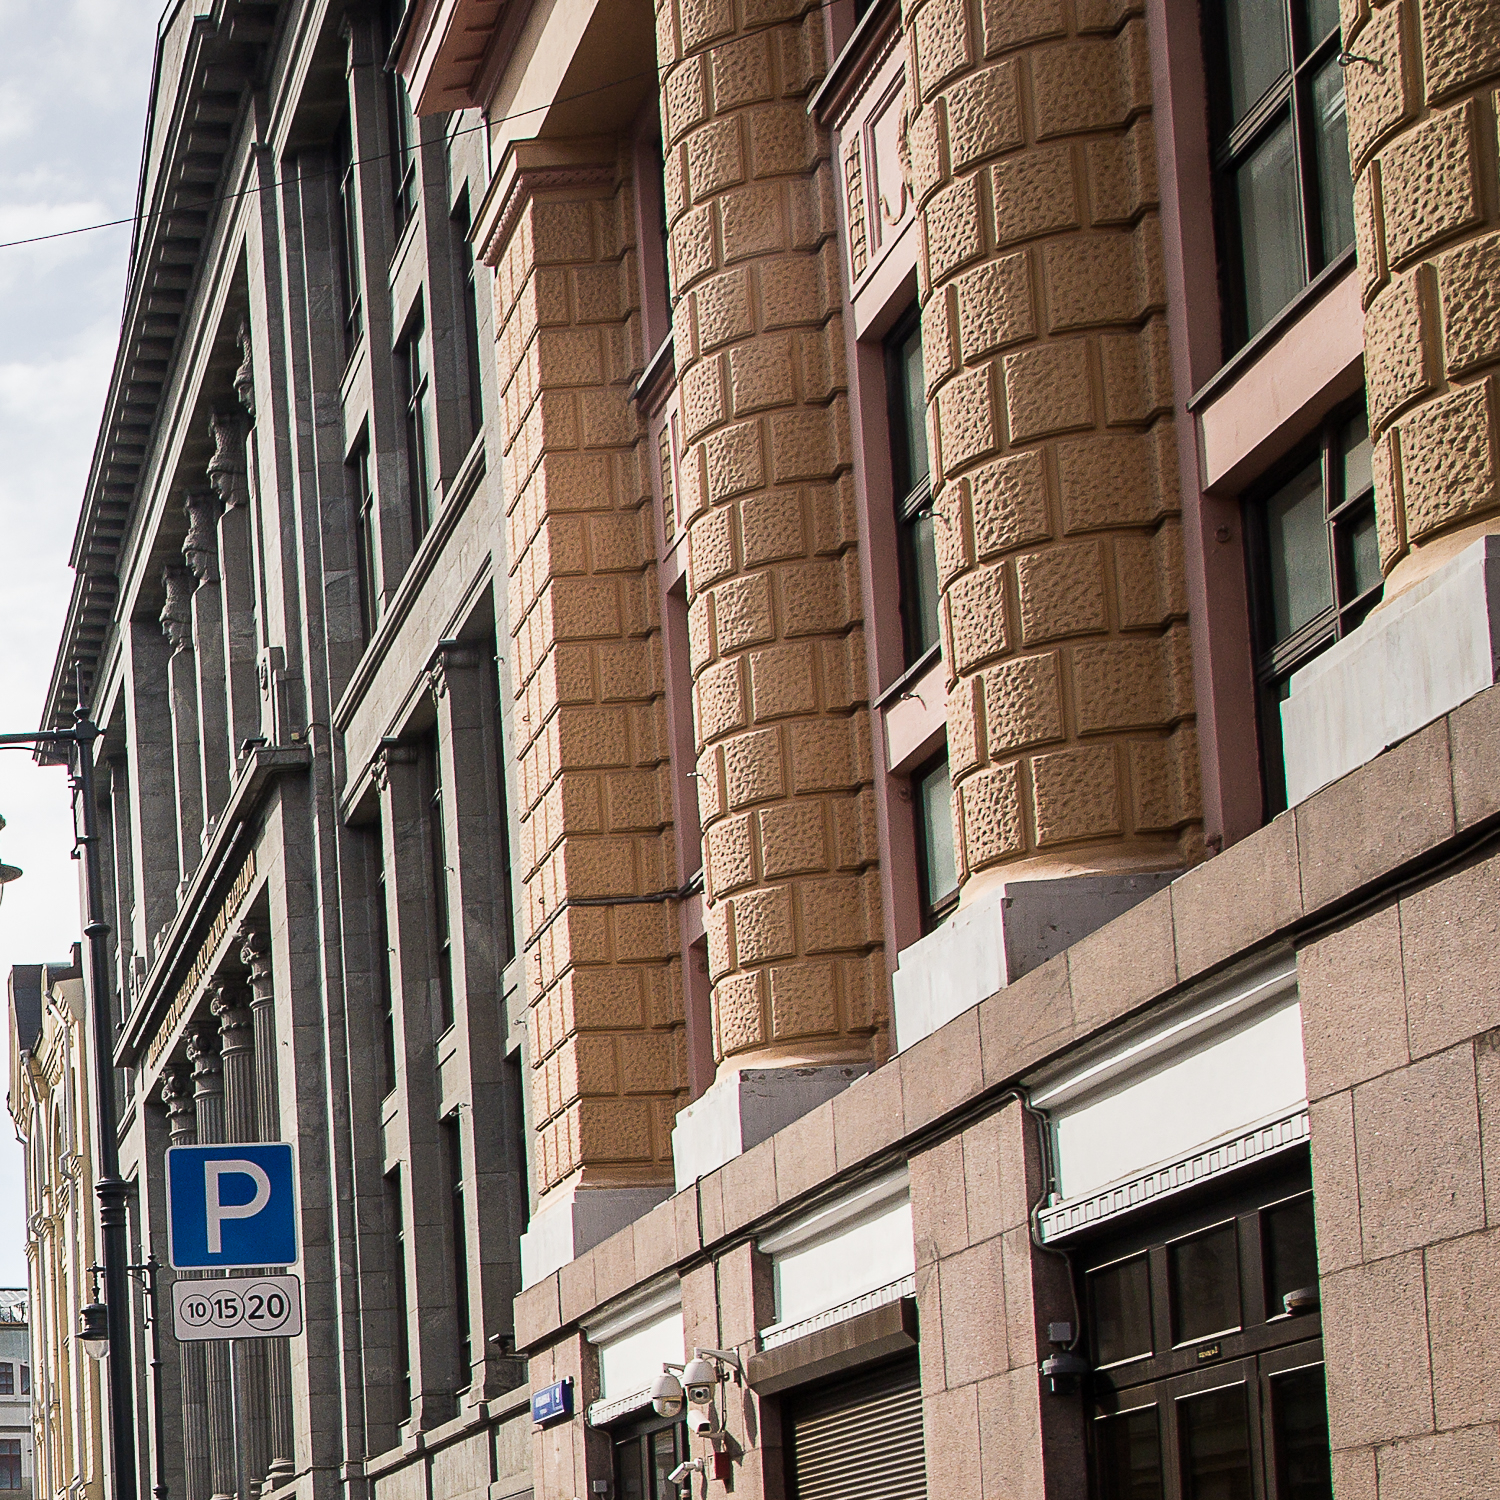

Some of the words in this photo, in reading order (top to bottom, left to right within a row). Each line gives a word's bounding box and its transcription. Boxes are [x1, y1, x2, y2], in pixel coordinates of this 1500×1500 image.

[204, 1159, 271, 1254] P
[187, 1302, 207, 1318] 10
[213, 1297, 238, 1320] 15
[247, 1293, 286, 1320] 20
